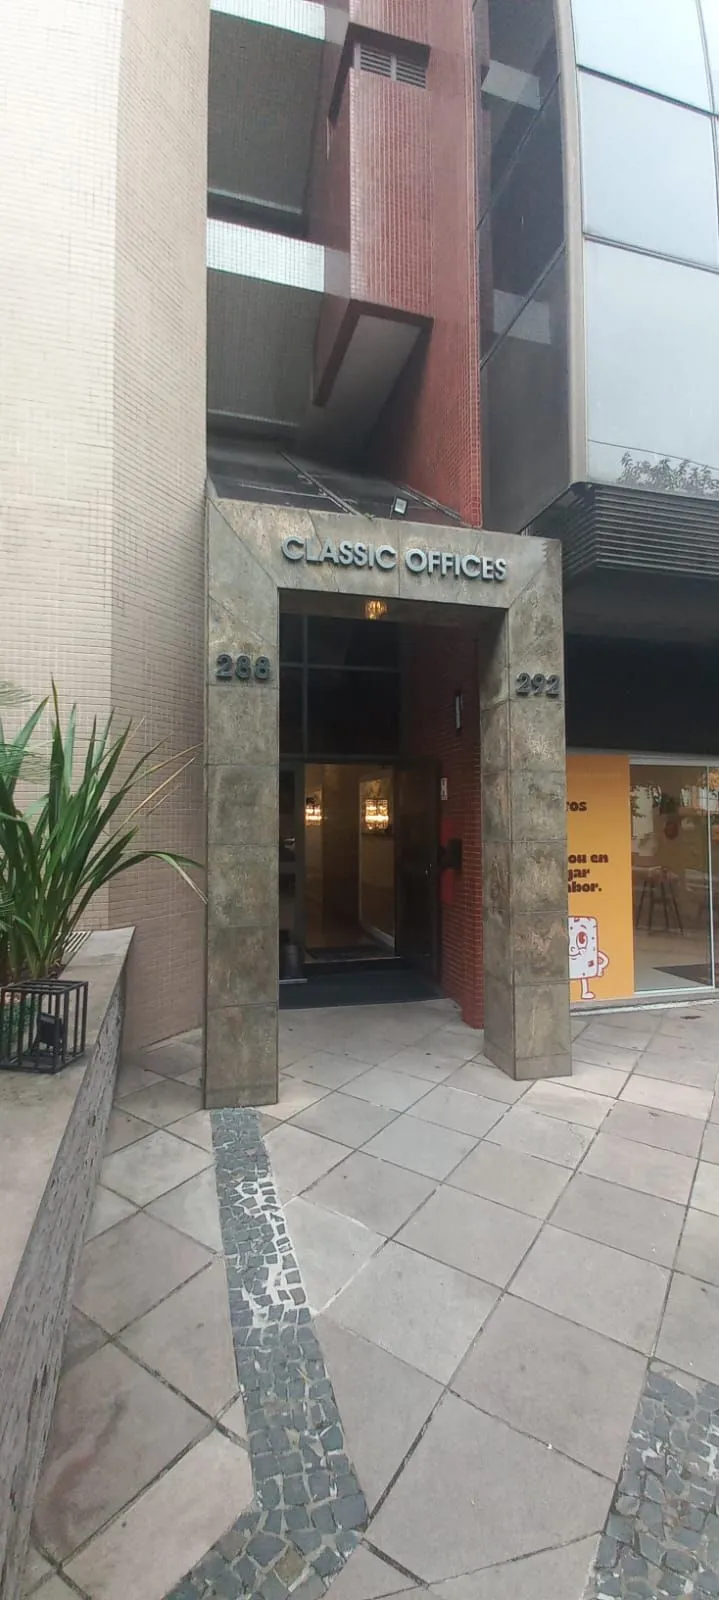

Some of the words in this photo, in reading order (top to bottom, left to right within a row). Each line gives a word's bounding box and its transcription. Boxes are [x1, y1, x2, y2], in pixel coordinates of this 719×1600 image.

[281, 536, 397, 570] CLASSIC
[405, 548, 508, 582] OFFICES
[215, 654, 270, 681] 288
[516, 672, 560, 698] 292
